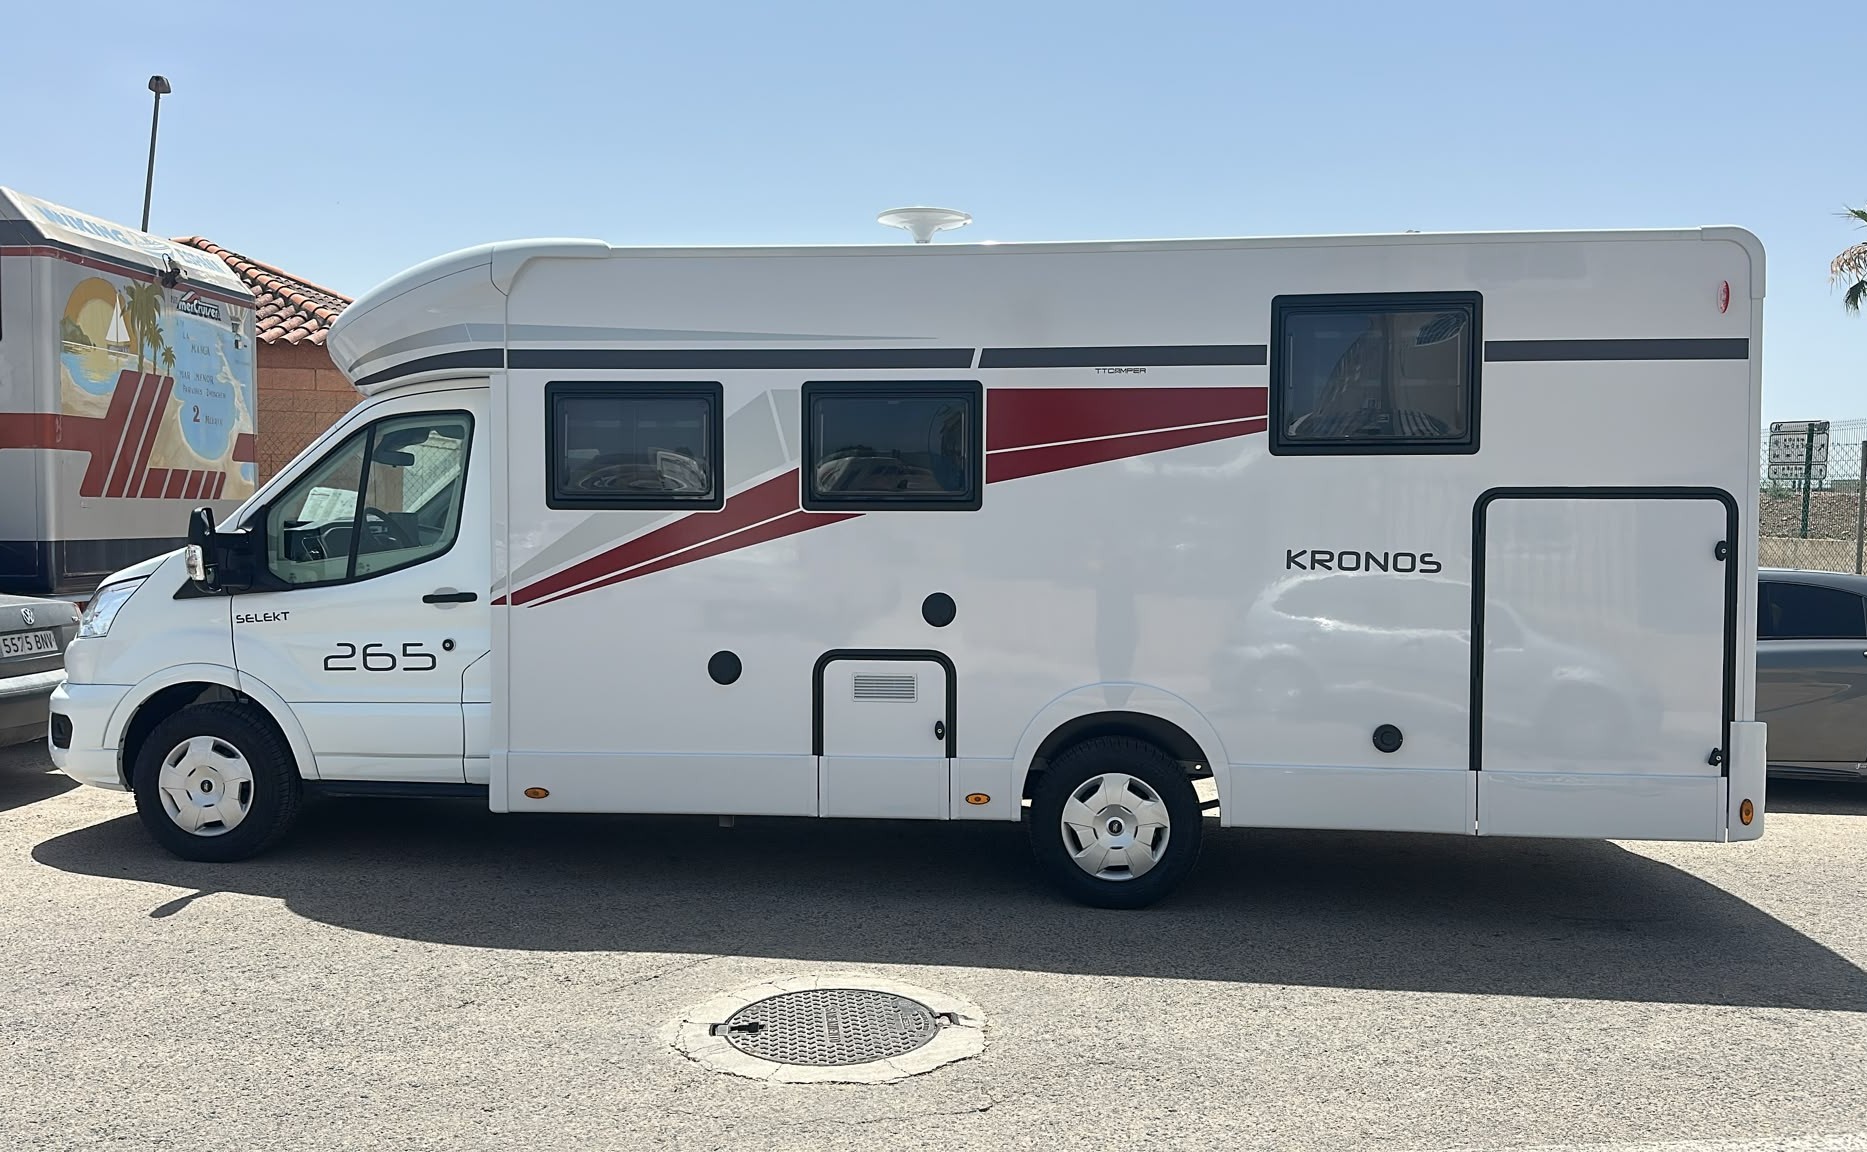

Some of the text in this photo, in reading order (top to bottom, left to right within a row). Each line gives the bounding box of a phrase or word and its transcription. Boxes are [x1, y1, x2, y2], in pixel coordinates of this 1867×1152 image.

[193, 404, 201, 423] 2
[1286, 549, 1442, 574] KRONOS
[2, 633, 54, 654] 5575 BNV
[323, 642, 437, 672] 265
